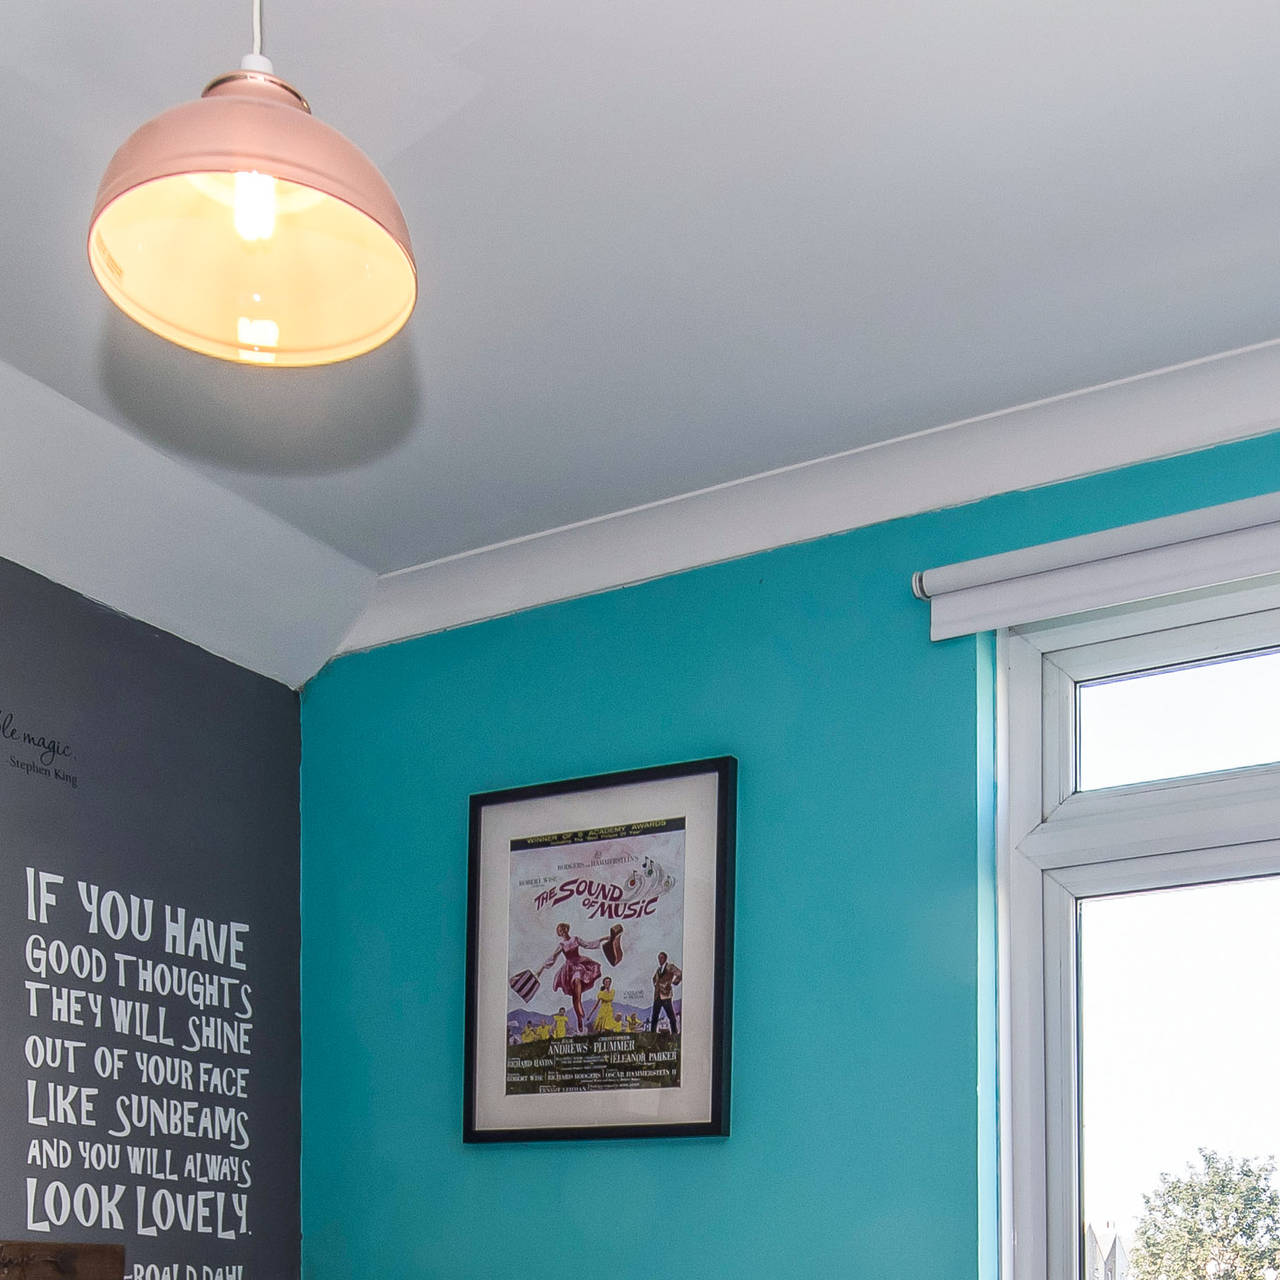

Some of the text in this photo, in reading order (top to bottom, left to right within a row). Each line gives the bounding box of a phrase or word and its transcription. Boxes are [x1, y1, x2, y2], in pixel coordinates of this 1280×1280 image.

[9, 755, 78, 788] Stephen King
[588, 825, 626, 836] ACADEMY
[631, 820, 667, 830] AWARDS
[25, 866, 250, 971] IF YOU HAVE
[534, 876, 623, 911] THE SOUND
[582, 896, 659, 920] OF MUSIC
[25, 934, 253, 1019] GOOD THOUGHTS
[24, 980, 254, 1055] THEY WILL SHINE
[24, 1035, 250, 1098] OUT OF YOUR FACE
[547, 1040, 635, 1055] ANDREWS PLUMMER
[612, 1052, 646, 1064] ELEANOR
[648, 1051, 677, 1062] PARKER
[26, 1079, 250, 1150] LIKE SUNBEAMS
[27, 1138, 252, 1188] AND YOU WILL ALWAYS
[26, 1177, 252, 1240] LOOK LOVELY.
